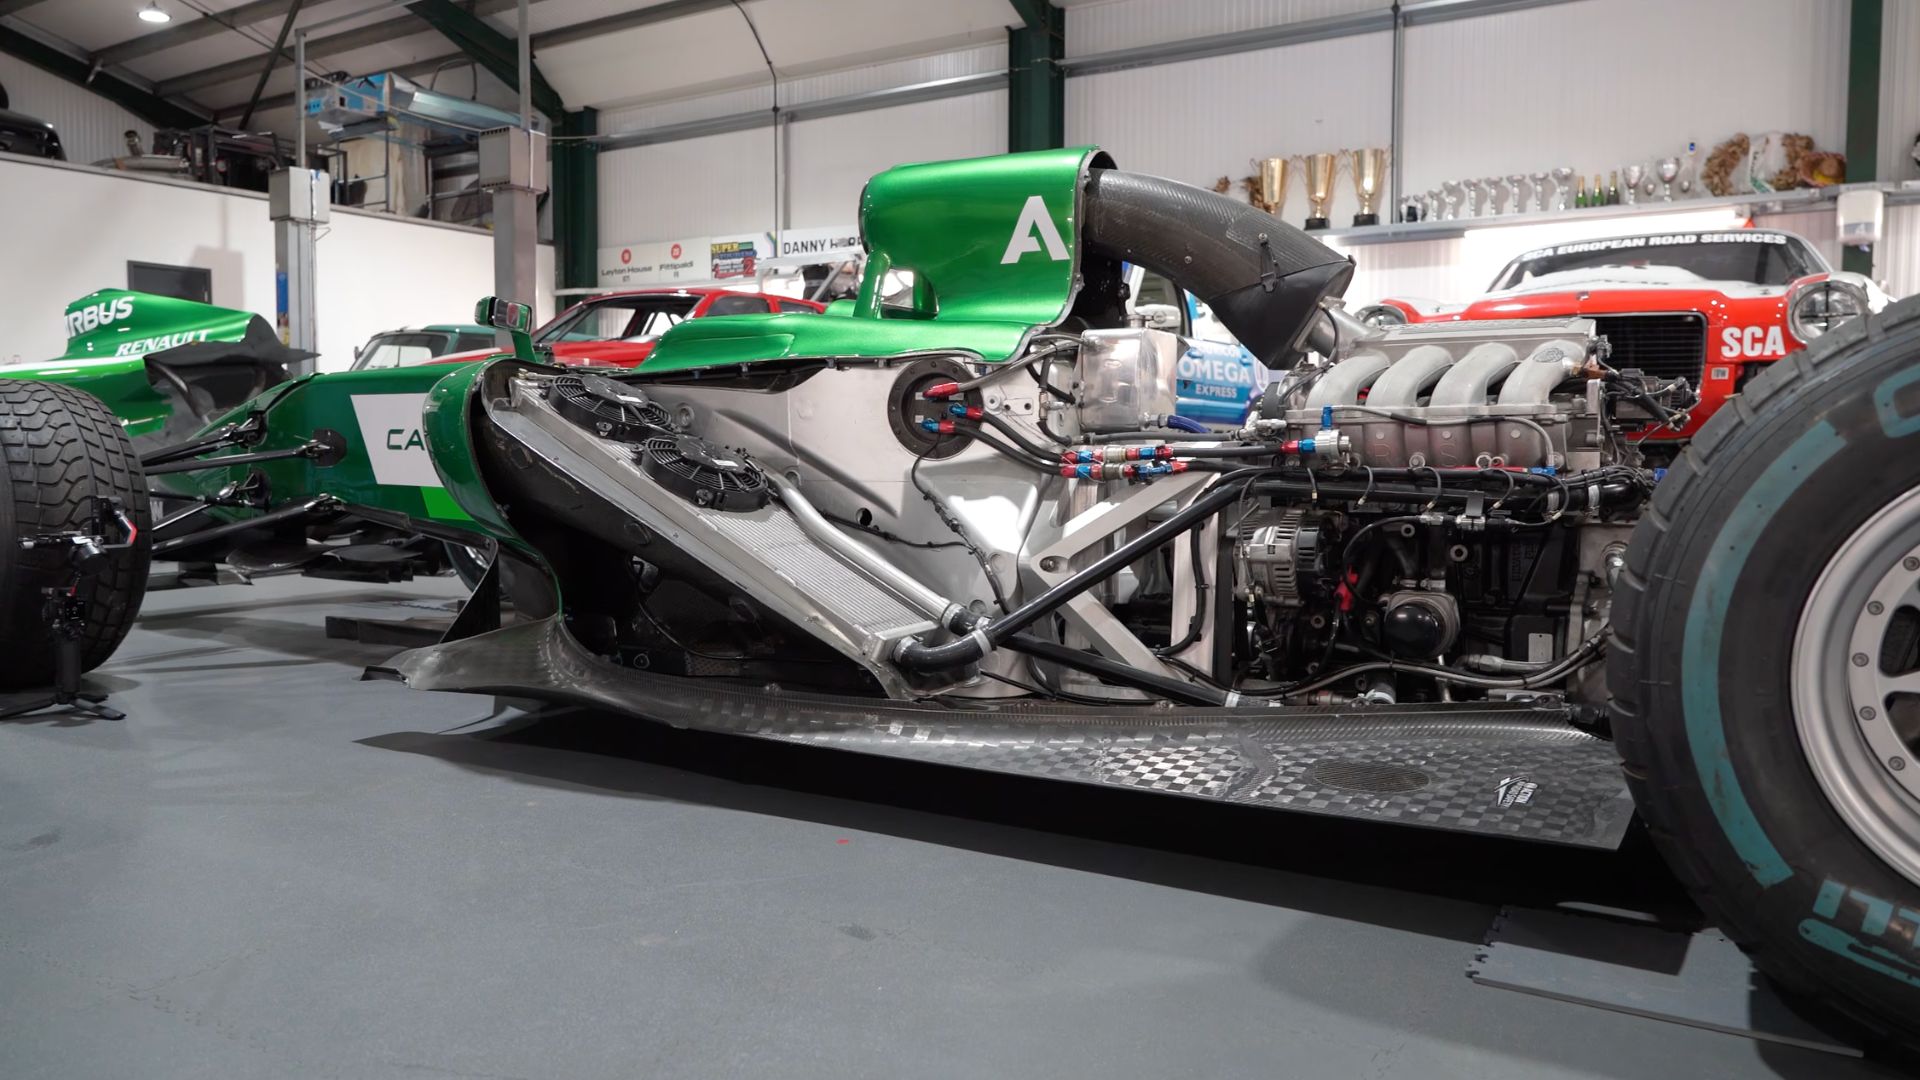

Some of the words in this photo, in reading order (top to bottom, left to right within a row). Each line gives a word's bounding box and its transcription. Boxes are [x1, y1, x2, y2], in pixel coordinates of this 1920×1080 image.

[1000, 195, 1071, 264] A
[784, 239, 827, 255] DANNY
[1557, 237, 1646, 255] EUROPEAN
[1648, 234, 1697, 246] ROAD
[1700, 233, 1787, 244] SERVICES
[115, 329, 213, 357] RENAULT
[1721, 325, 1786, 358] SCA
[1178, 356, 1250, 384] OMEGA
[1195, 384, 1237, 398] EXPRESS
